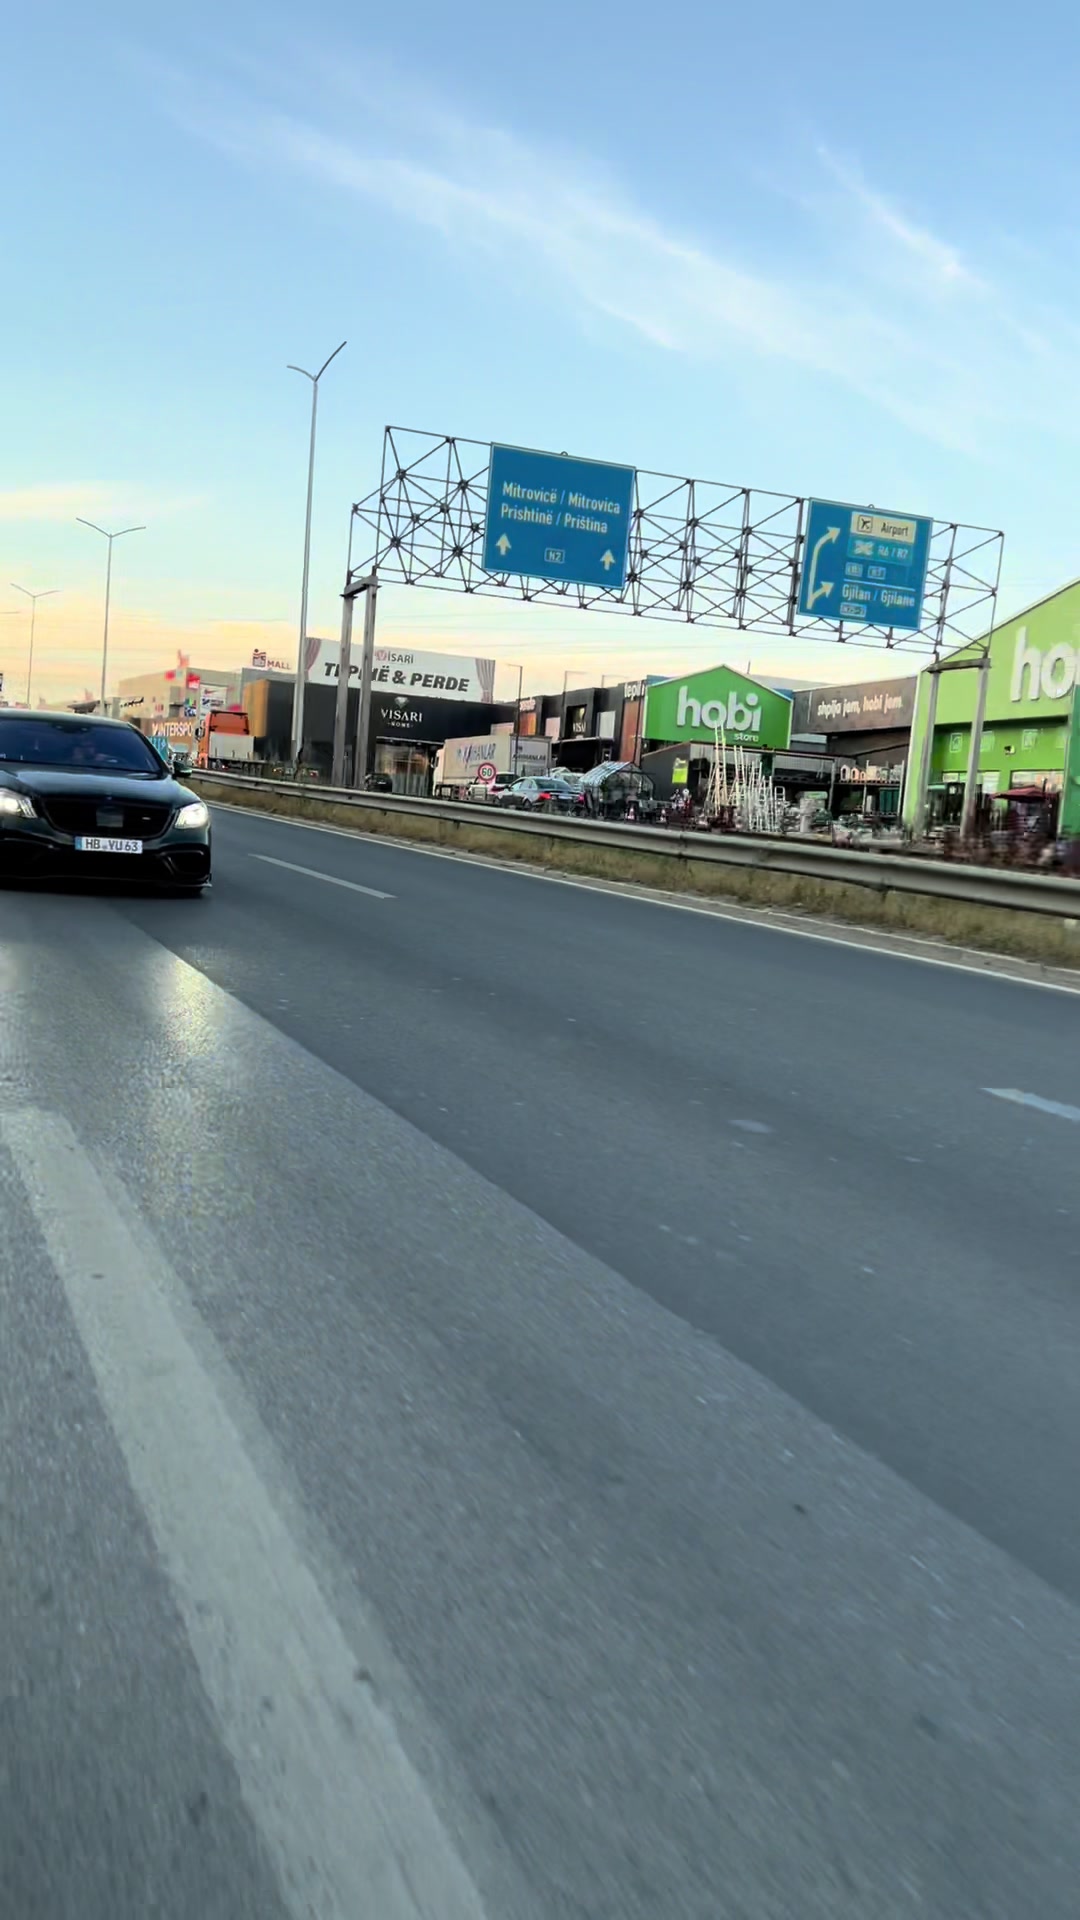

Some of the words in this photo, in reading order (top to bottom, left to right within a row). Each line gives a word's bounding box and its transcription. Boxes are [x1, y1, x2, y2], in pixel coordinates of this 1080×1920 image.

[502, 481, 557, 503] Mitrovicë
[568, 492, 620, 515] Mitrovica
[500, 502, 553, 525] Prishtinë
[563, 513, 607, 533] Priština
[881, 522, 908, 536] Airport
[549, 551, 561, 560] N2
[842, 583, 871, 601] Gjilan
[881, 589, 915, 608] Gjilane
[267, 659, 291, 670] MALL
[391, 669, 407, 685] &
[410, 672, 471, 693] PERDE
[380, 707, 424, 723] VISARI
[676, 685, 763, 732] hobi
[733, 732, 760, 743] store
[481, 767, 493, 777] 60
[85, 838, 101, 850] HB
[125, 841, 138, 852] 63
